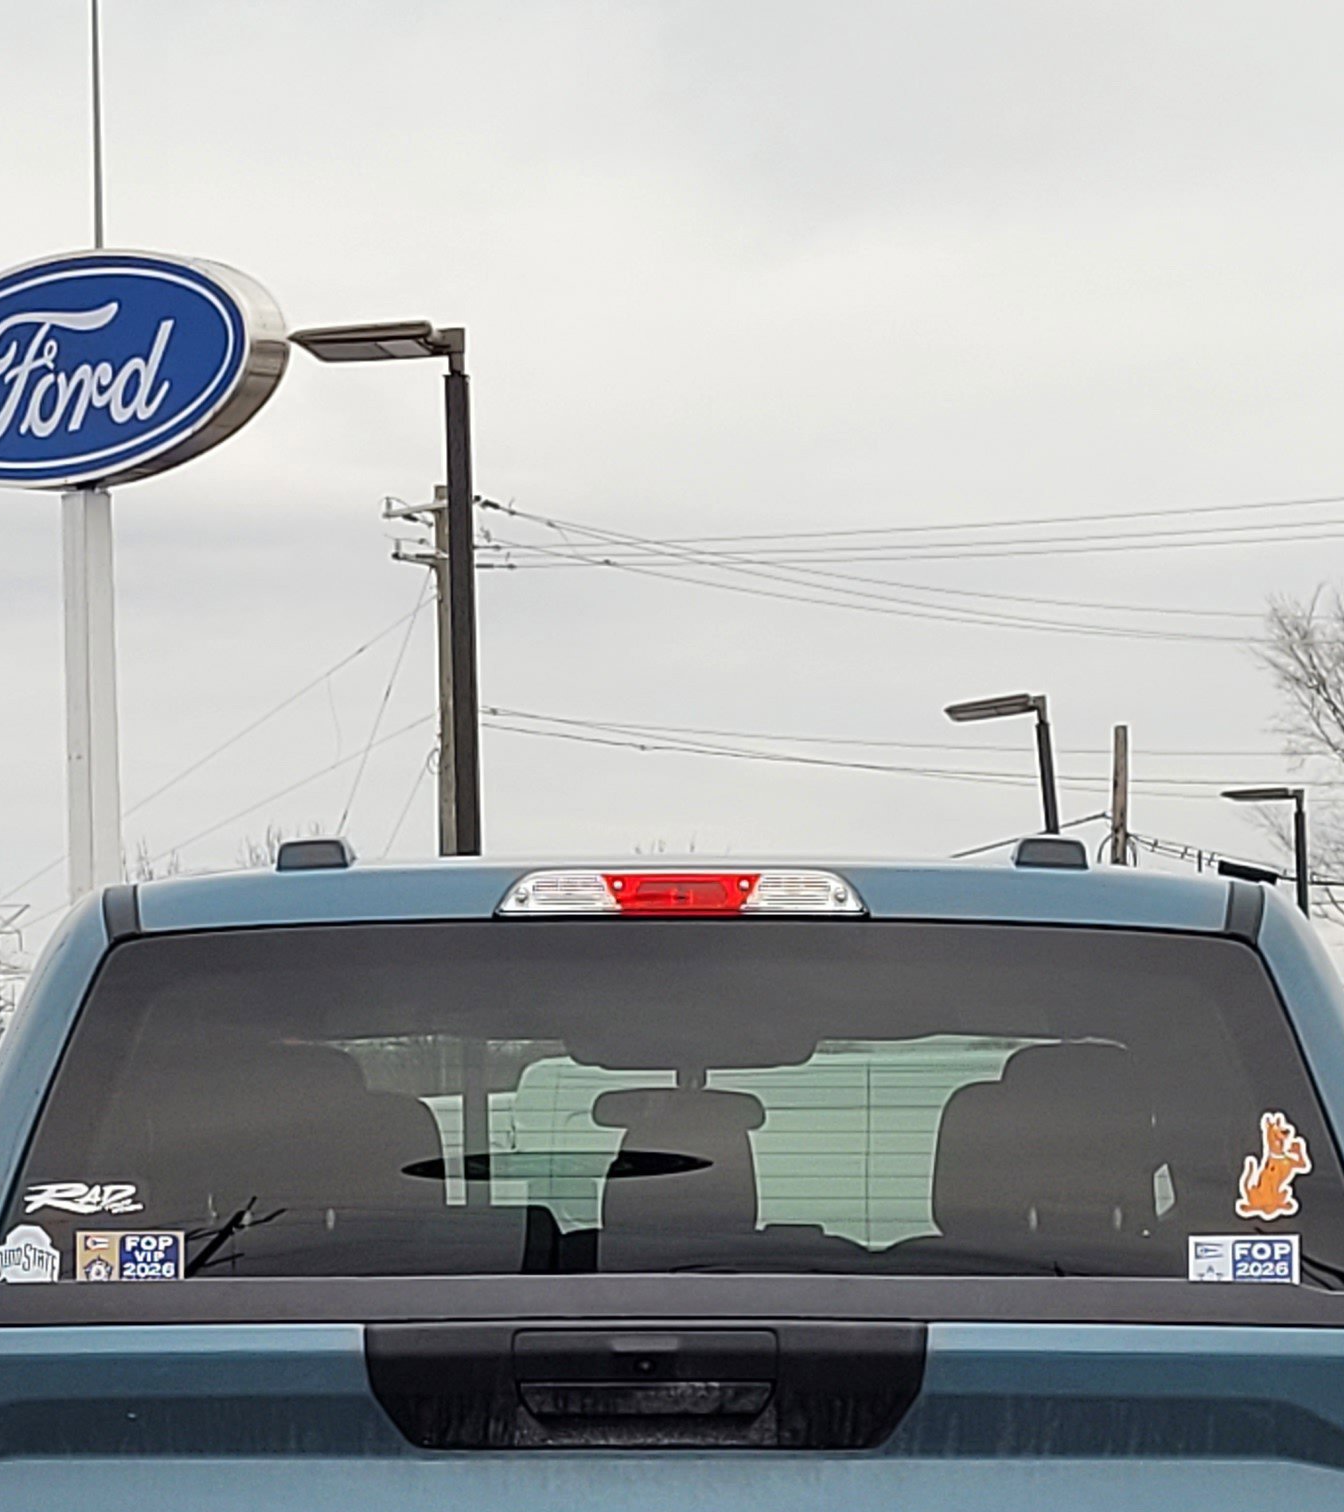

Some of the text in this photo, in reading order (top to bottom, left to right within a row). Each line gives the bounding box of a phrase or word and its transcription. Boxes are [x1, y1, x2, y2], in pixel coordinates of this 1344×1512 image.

[124, 1235, 174, 1252] FOP
[134, 1251, 166, 1263] VIP
[1234, 1243, 1291, 1261] FOP
[24, 1243, 57, 1283] STATE
[122, 1262, 175, 1278] 2026
[1235, 1261, 1289, 1276] 2026
